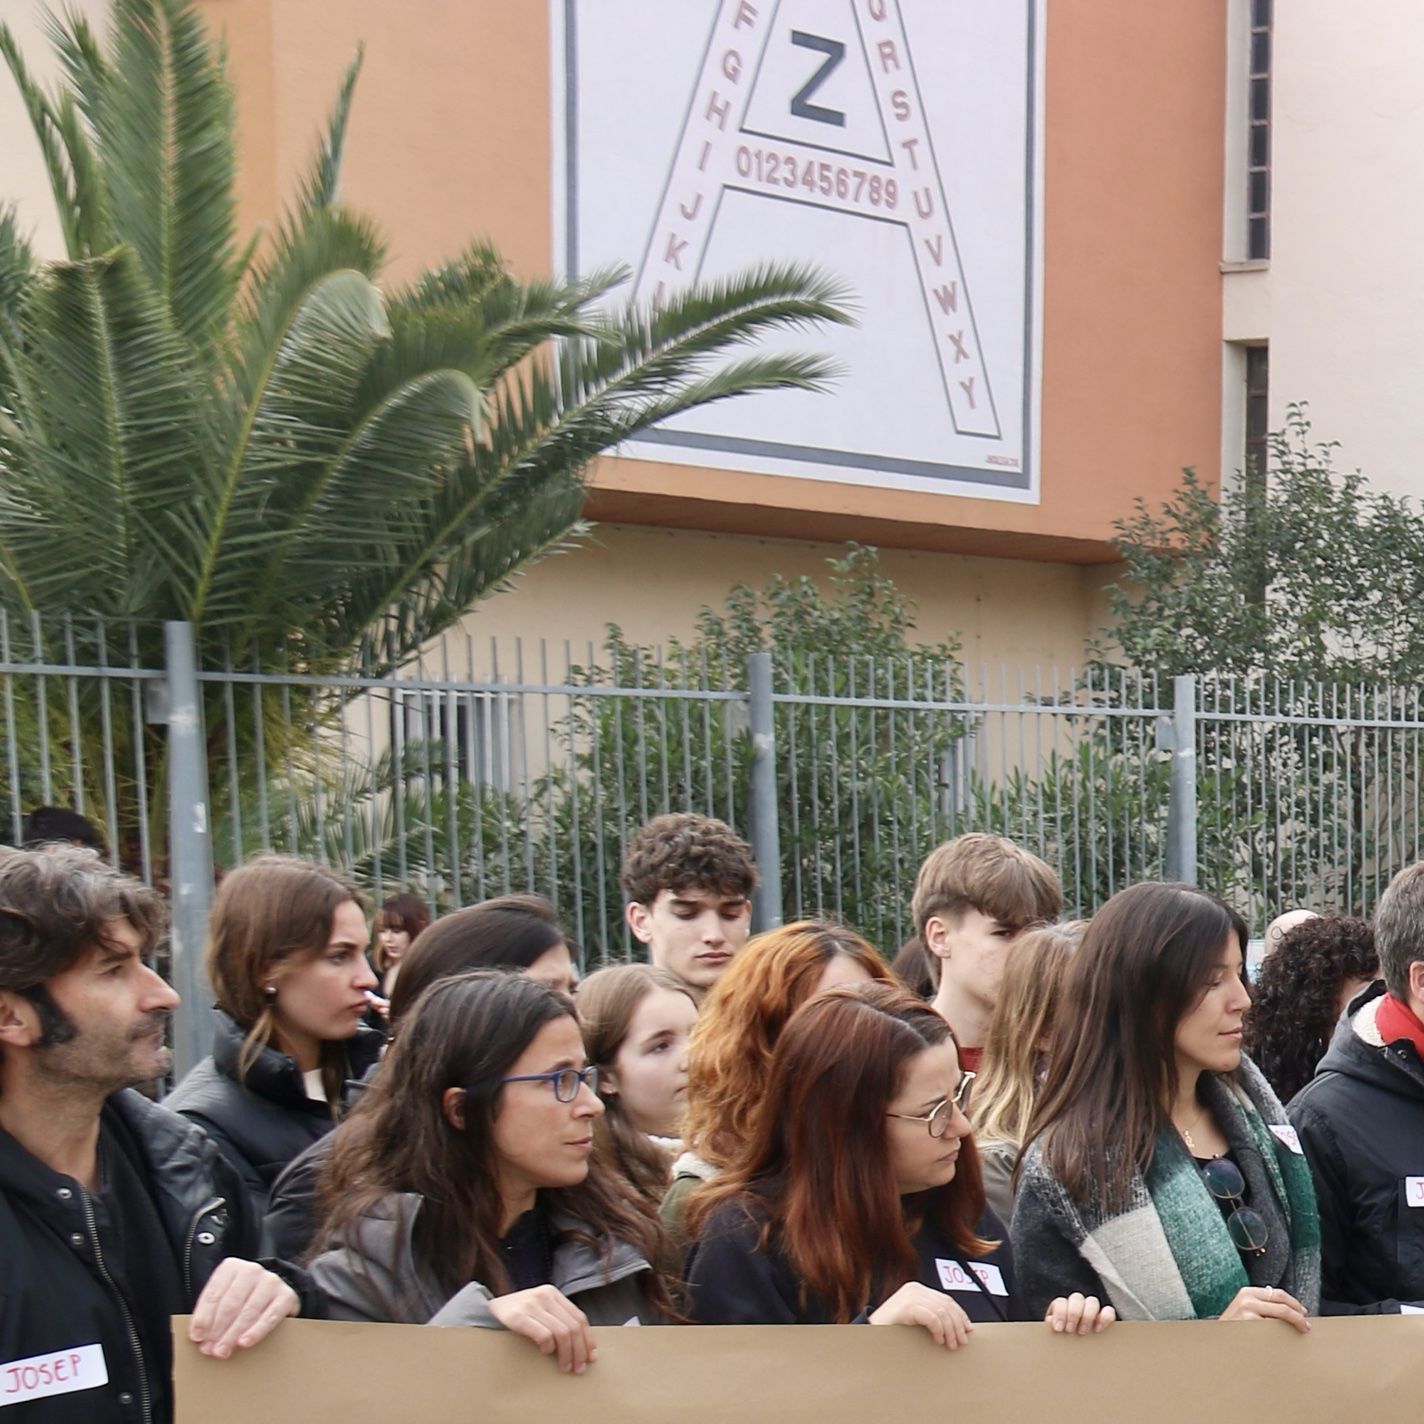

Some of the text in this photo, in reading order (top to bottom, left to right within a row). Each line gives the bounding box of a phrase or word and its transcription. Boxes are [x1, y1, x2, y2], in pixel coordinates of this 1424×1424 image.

[790, 29, 847, 128] Z
[735, 145, 898, 210] 0123456789
[5, 1353, 82, 1393] JOSEP
